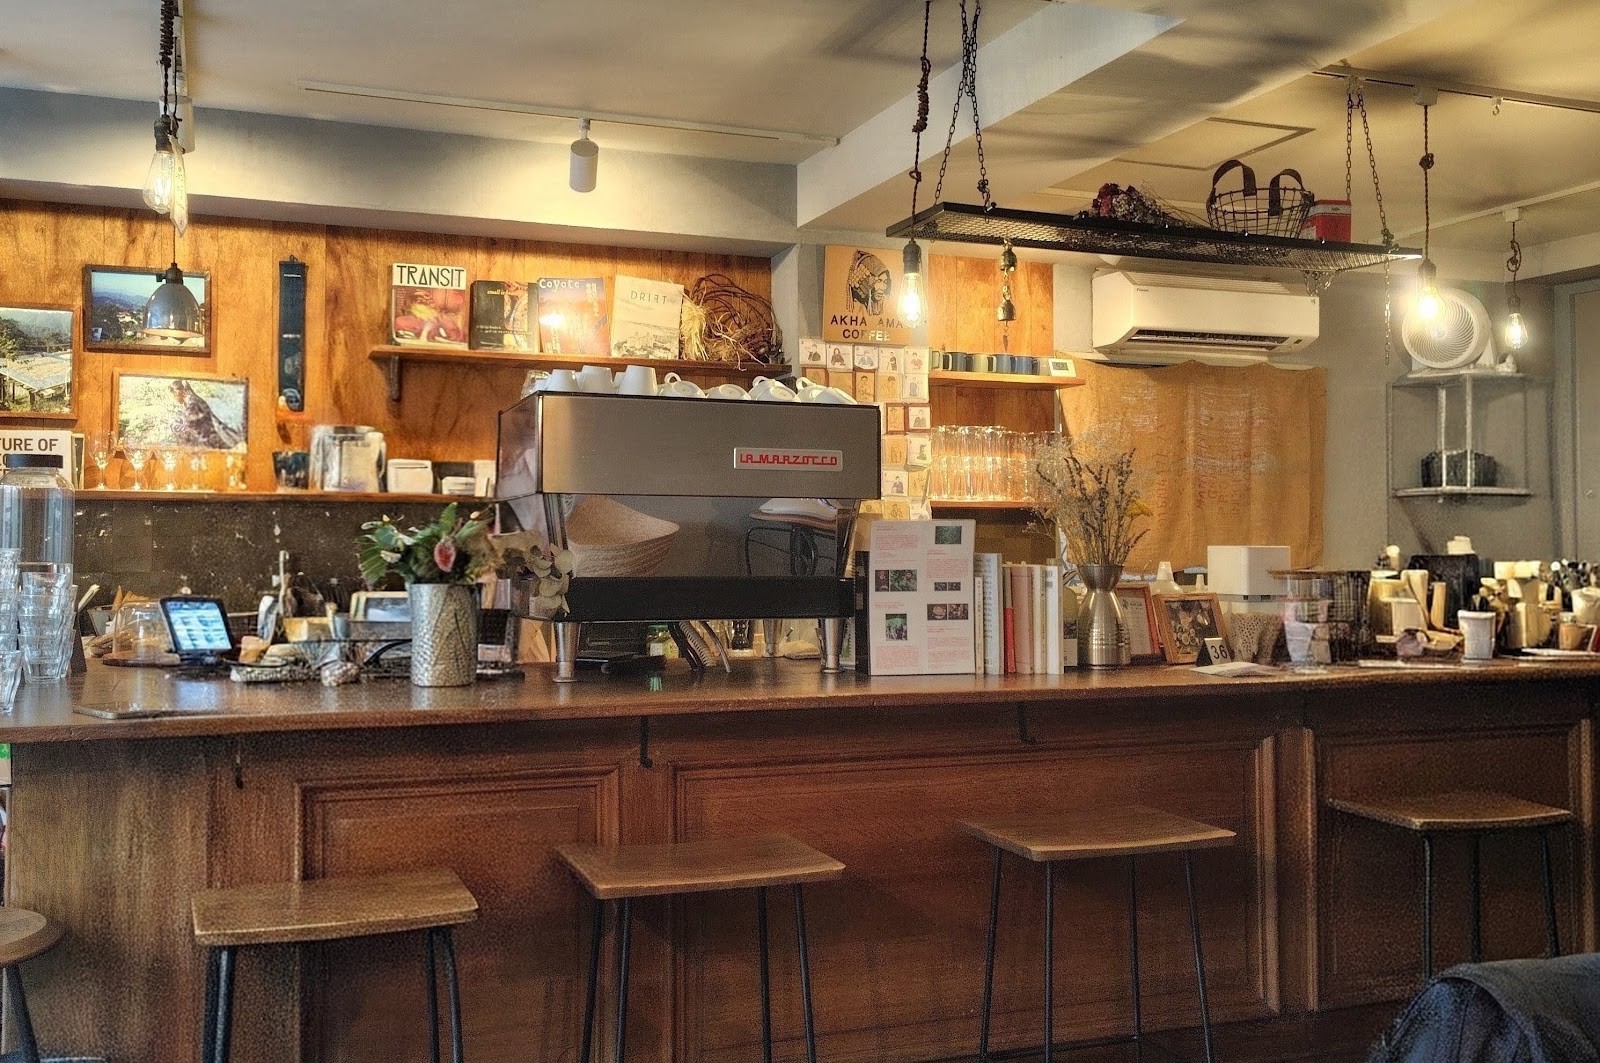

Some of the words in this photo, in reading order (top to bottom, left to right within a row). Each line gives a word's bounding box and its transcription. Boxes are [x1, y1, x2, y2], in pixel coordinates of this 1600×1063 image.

[397, 265, 464, 287] TRANSIT
[631, 290, 667, 304] DRIFT
[830, 314, 867, 326] AKHA
[877, 317, 904, 328] AMA
[842, 328, 891, 341] COFFEE
[0, 437, 33, 451] URE
[38, 438, 58, 451] OF
[1211, 644, 1228, 659] 36
